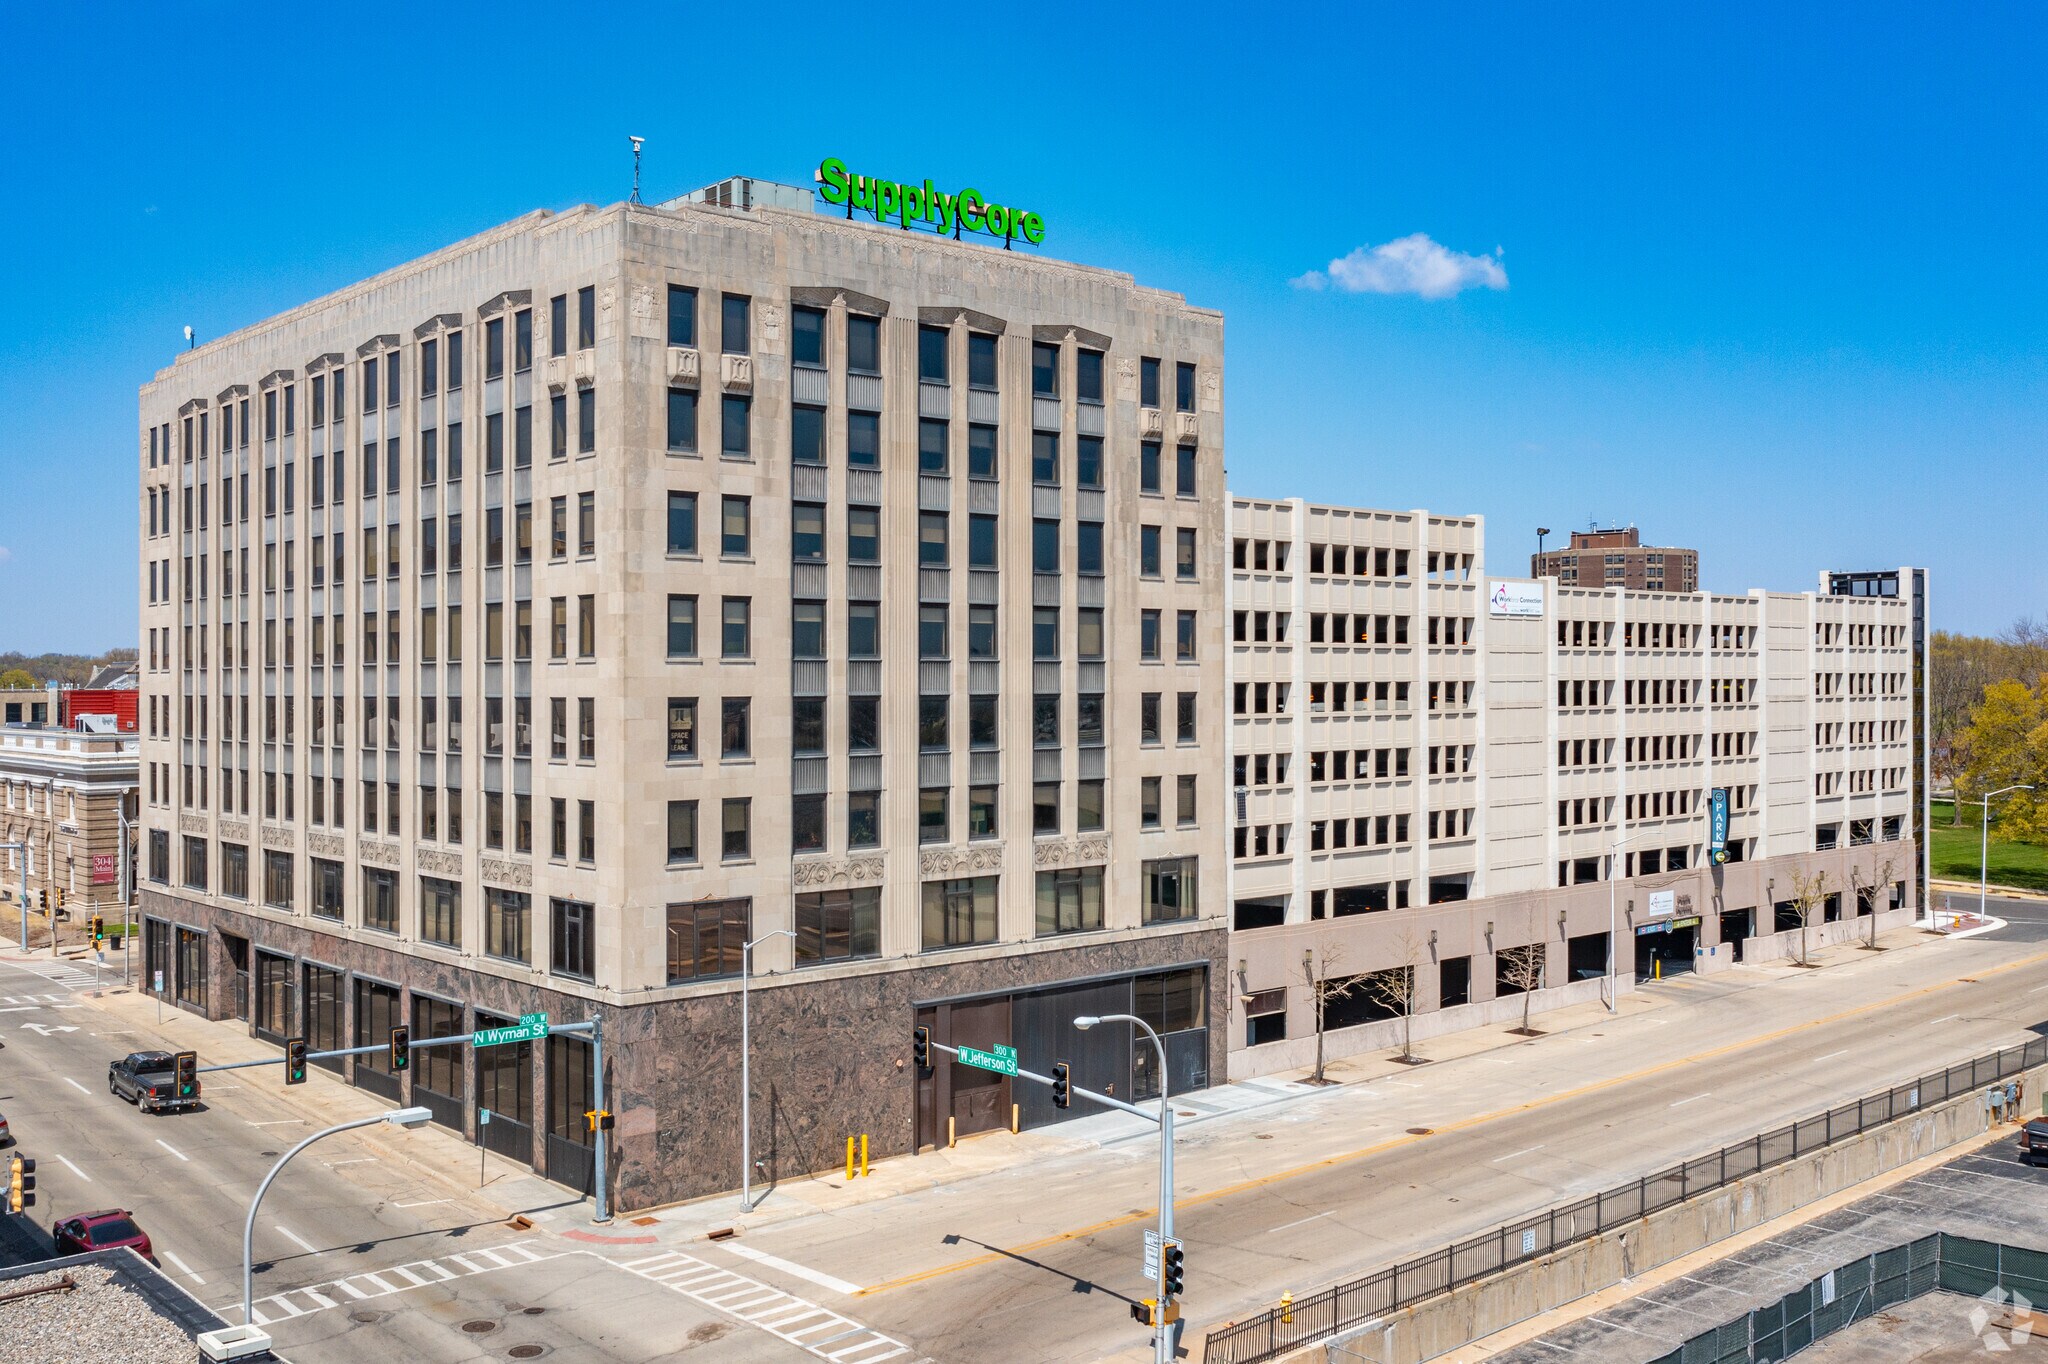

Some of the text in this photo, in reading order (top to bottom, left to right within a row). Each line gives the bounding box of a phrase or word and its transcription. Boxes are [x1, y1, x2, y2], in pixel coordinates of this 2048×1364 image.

[819, 157, 1046, 244] SupplyCore
[1715, 803, 1723, 841] PARK
[95, 857, 112, 866] 304
[521, 1015, 536, 1025] 200
[474, 1023, 545, 1044] N Wyman St
[960, 1048, 1016, 1074] W Jefferson St
[994, 1045, 1007, 1056] 300
